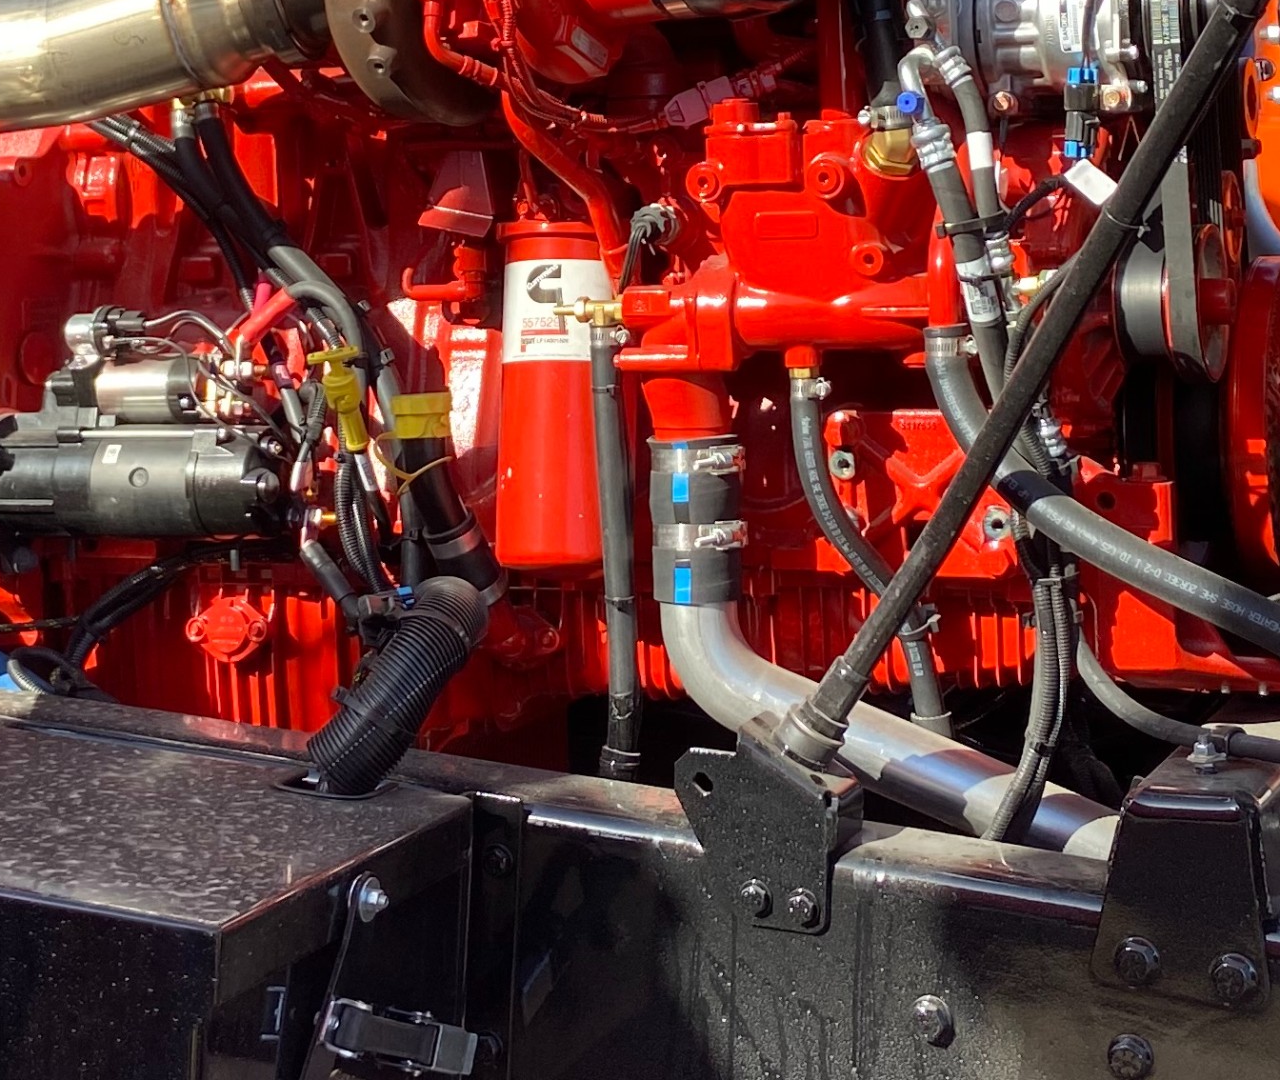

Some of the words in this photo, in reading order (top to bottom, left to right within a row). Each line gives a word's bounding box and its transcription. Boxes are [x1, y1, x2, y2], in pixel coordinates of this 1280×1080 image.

[527, 264, 559, 290] Cummins
[1198, 586, 1219, 604] SAE
[1219, 596, 1245, 617] HOSE
